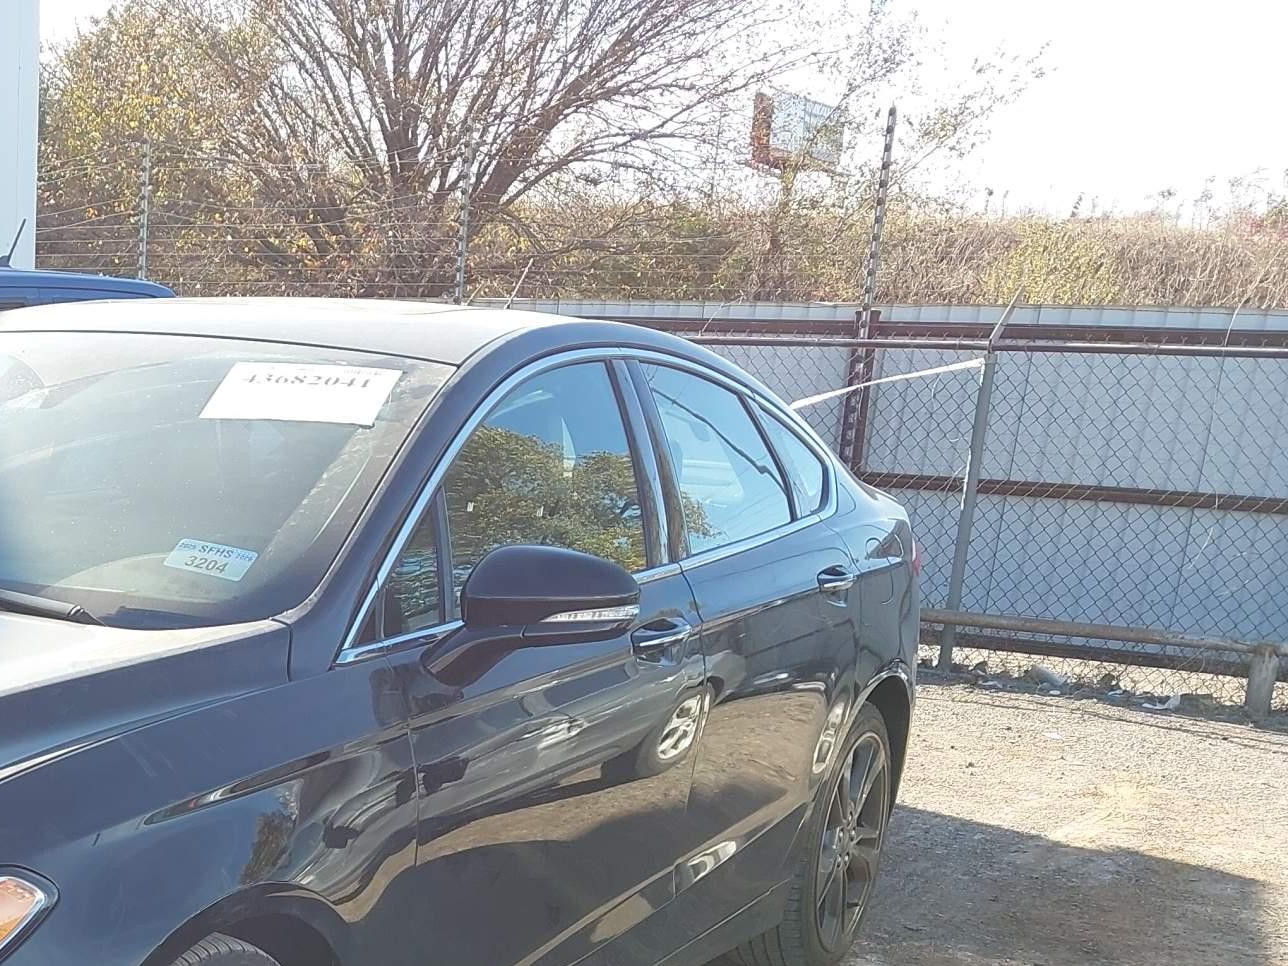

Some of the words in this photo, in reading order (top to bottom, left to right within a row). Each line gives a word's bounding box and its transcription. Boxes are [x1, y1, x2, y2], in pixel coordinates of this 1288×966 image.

[242, 373, 371, 388] 43682041
[199, 545, 234, 558] SFHS
[184, 555, 230, 574] 3204
